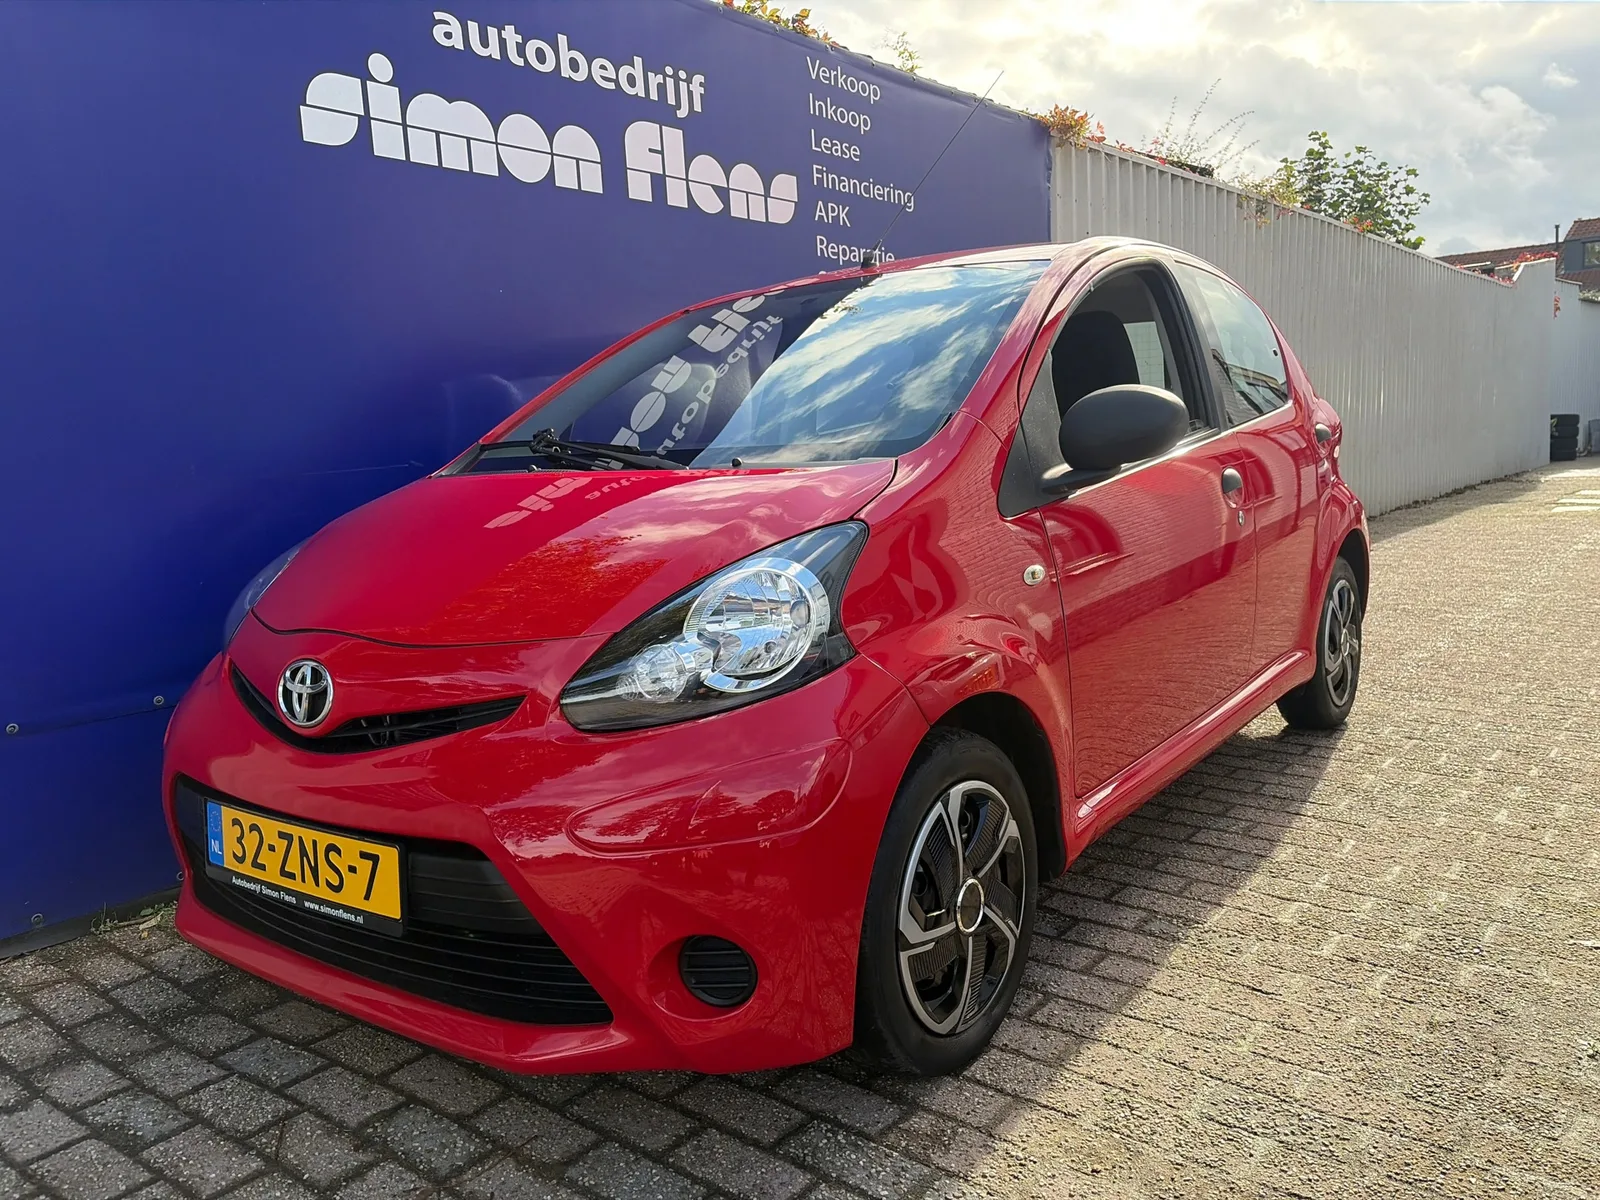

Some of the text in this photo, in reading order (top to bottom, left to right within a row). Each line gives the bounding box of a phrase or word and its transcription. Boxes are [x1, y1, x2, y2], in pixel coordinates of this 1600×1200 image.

[433, 11, 704, 117] autobedrijf
[806, 56, 881, 104] Verkoop
[808, 93, 871, 134] Inkoop
[811, 129, 860, 161] Lease
[812, 164, 914, 212] Financiering
[815, 200, 851, 228] APK
[816, 235, 895, 266] Repartie
[211, 838, 222, 855] NL
[231, 817, 380, 901] 32-ZNS-7
[232, 875, 364, 925] Autobedrijf Simon Flens www.simonflens.nl
